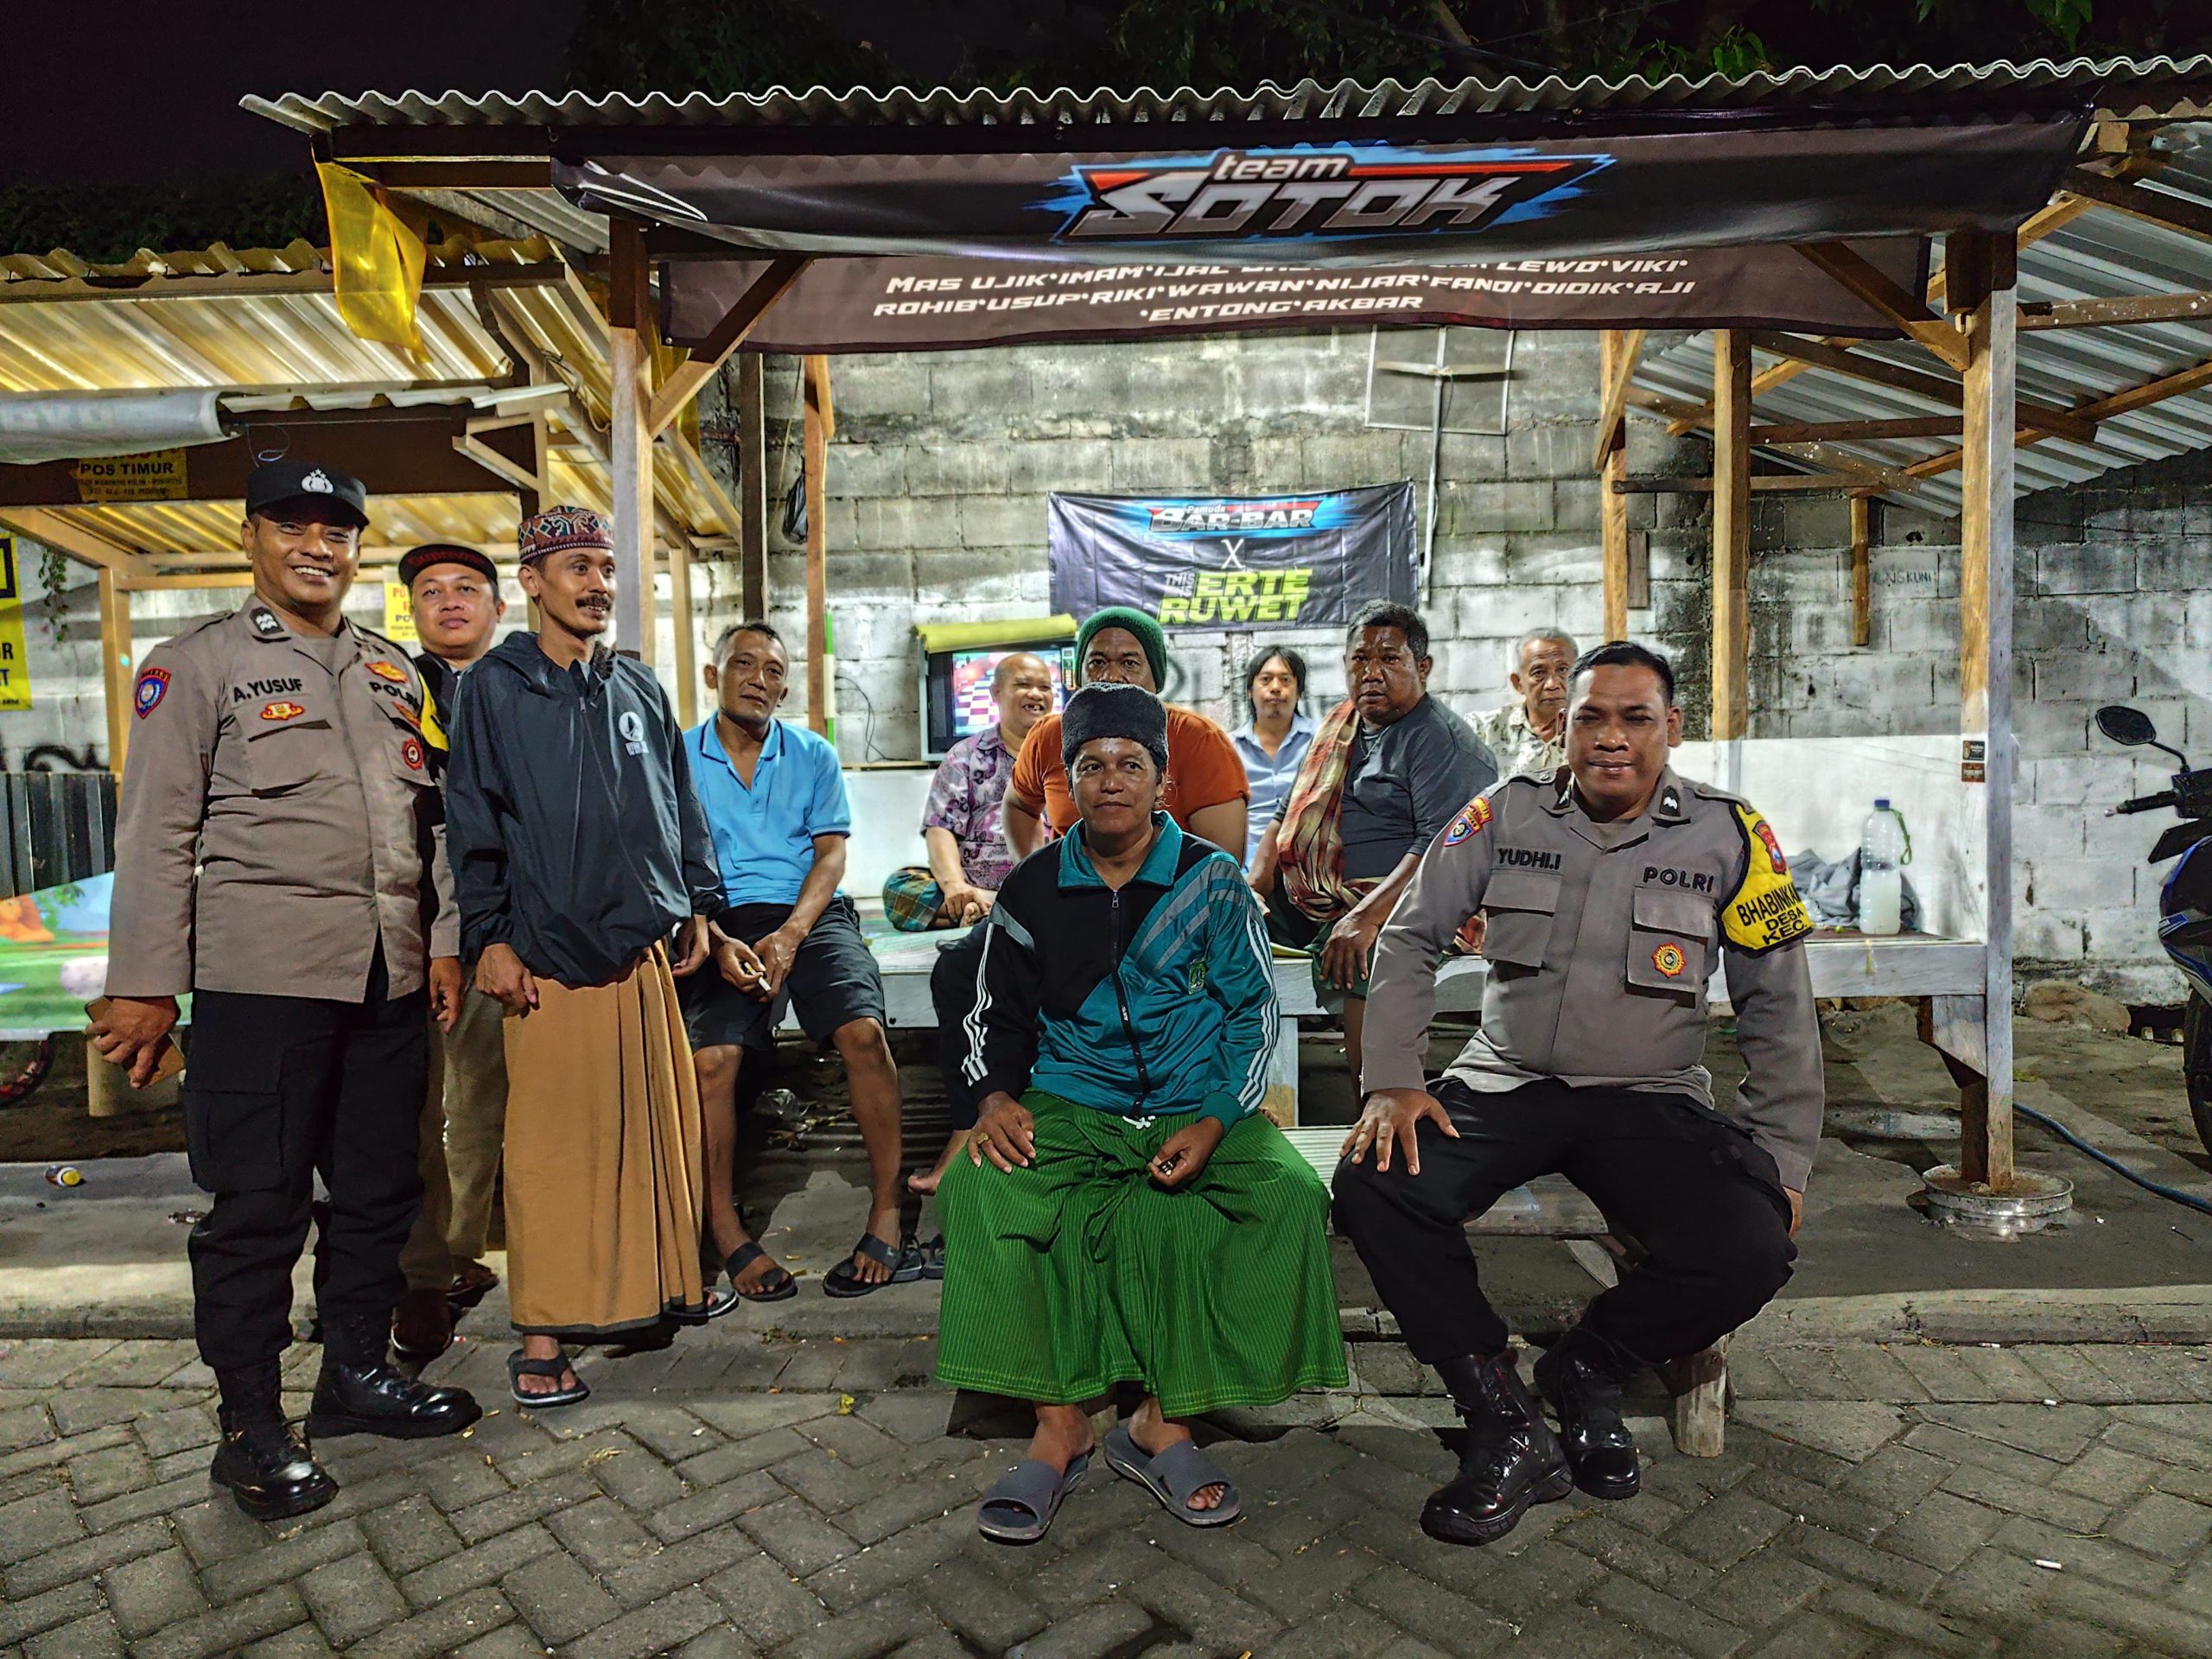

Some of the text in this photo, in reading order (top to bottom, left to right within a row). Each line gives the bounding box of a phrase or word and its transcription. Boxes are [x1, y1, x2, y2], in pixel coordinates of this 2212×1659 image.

[1213, 156, 1348, 180] team
[1069, 171, 1521, 235] SOTOK
[79, 462, 174, 475] POS TIMUR
[1149, 506, 1314, 531] BAR-BAR
[1196, 569, 1313, 598] ERTE
[1157, 593, 1307, 624] RUWET
[233, 677, 303, 703] A.YUSUF
[1643, 867, 1714, 893] POLRI
[1764, 906, 1804, 931] DESA
